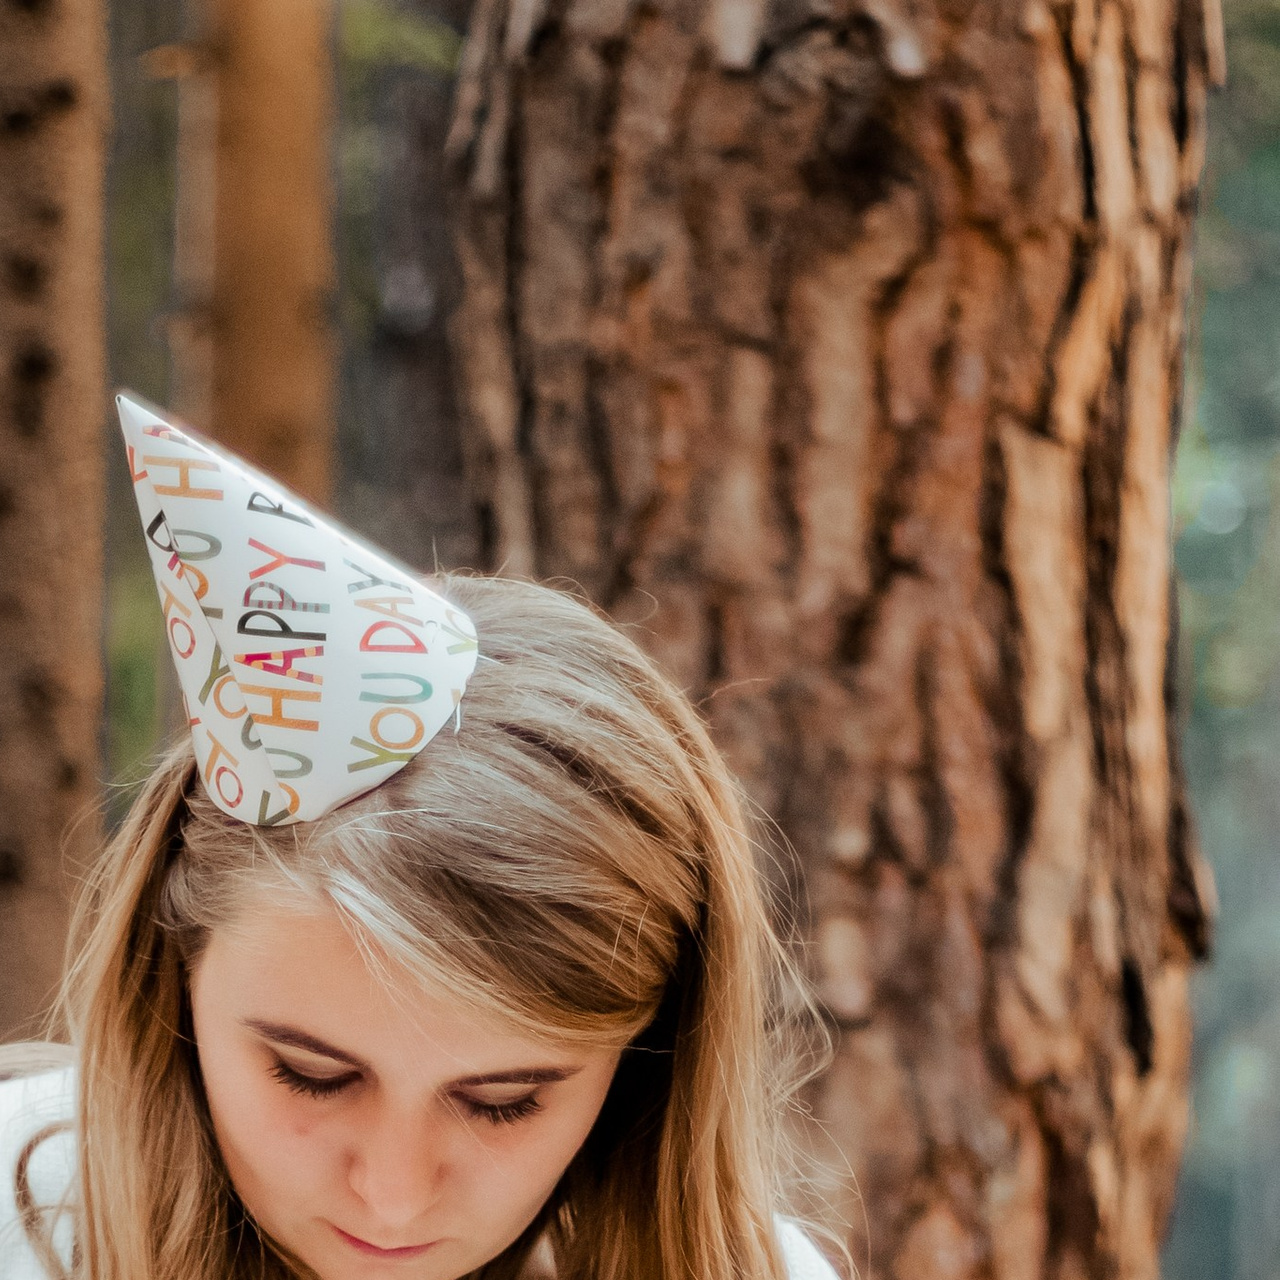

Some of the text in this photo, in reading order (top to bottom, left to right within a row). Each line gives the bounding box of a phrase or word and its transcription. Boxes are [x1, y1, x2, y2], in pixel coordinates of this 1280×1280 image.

[234, 537, 330, 732] HAPPY
[343, 557, 434, 774] YOU DAY
